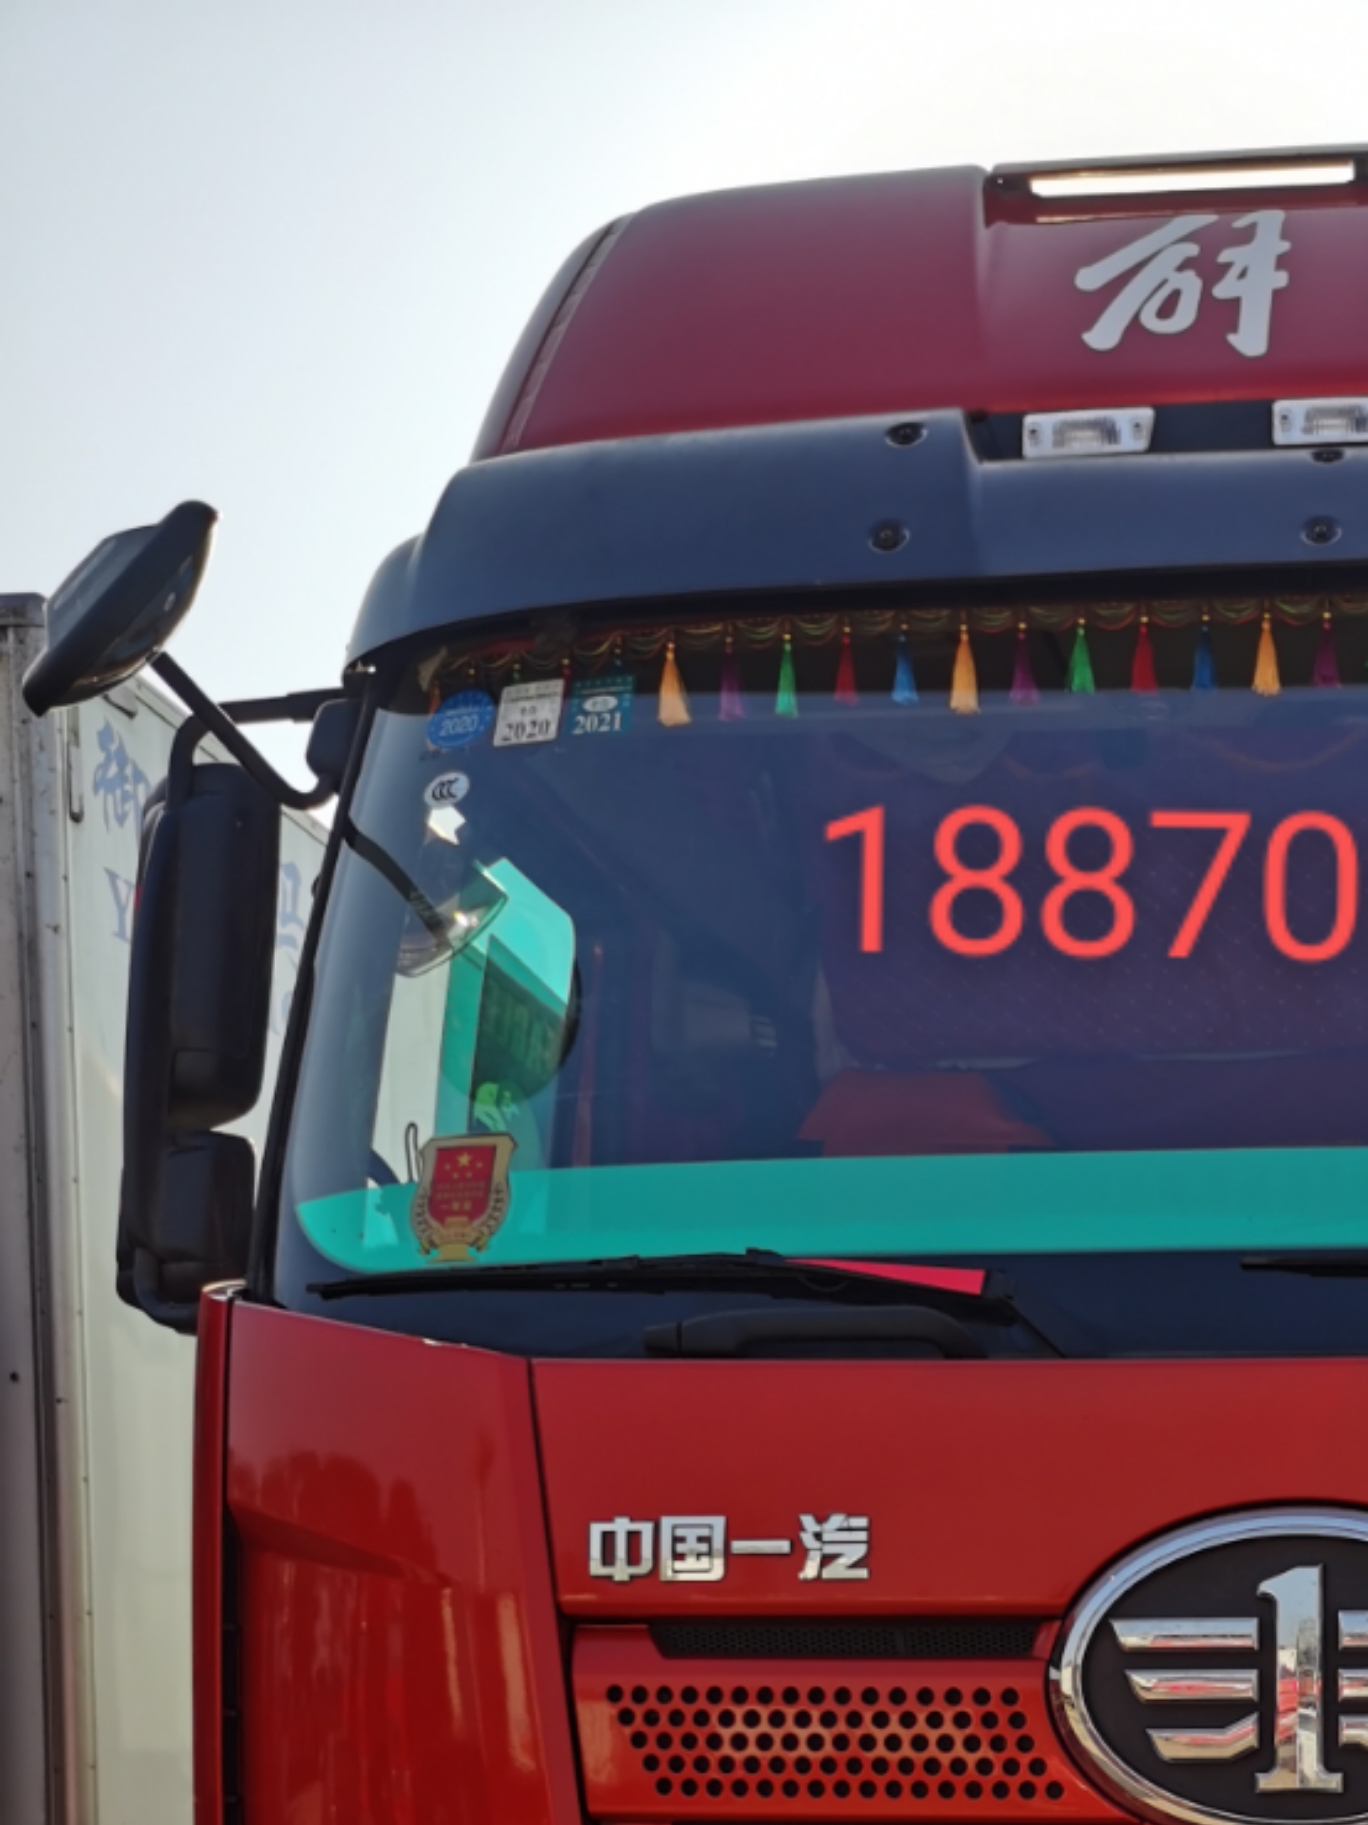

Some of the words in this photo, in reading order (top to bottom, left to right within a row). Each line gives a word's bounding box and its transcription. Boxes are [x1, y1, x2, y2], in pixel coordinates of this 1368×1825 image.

[438, 713, 479, 737] 2020
[501, 716, 550, 741] 2020
[572, 711, 623, 736] 2021
[588, 1513, 870, 1582] 中国一汽
